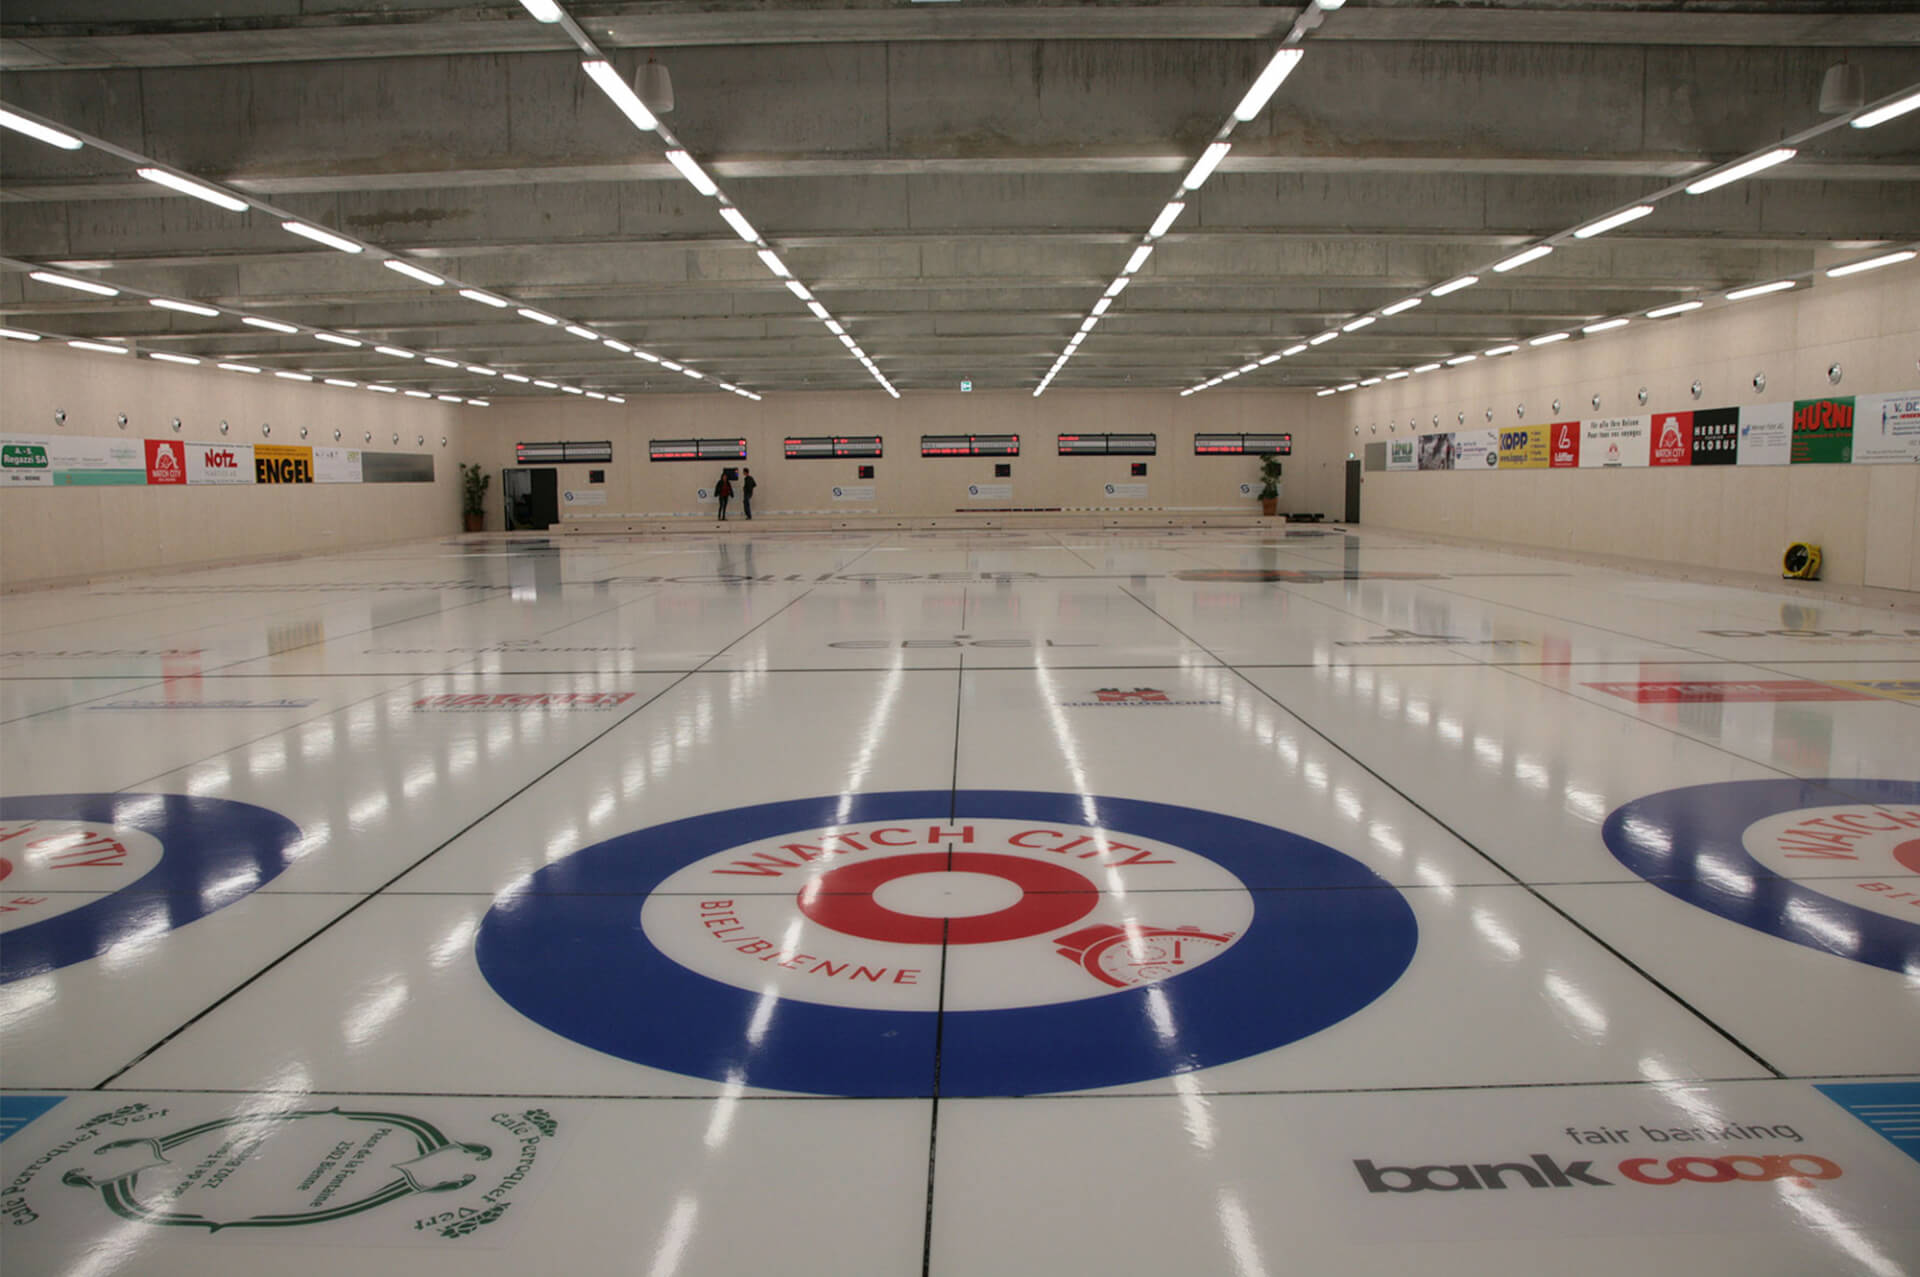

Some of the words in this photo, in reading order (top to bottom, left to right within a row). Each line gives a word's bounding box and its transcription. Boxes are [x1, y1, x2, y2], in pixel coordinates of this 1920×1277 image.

[1793, 400, 1853, 431] HURNI
[1500, 431, 1528, 450] KOPP
[1694, 424, 1736, 436] HERREN
[1693, 439, 1736, 451] GLOBUS
[35, 455, 47, 465] SA
[255, 458, 313, 484] ENGEL
[711, 825, 975, 878] WATCH
[1007, 829, 1178, 871] CITY
[700, 898, 922, 987] BIEL/BIENNE
[109, 1108, 170, 1127] Vert
[1565, 1126, 1631, 1146] fair
[1646, 1121, 1805, 1146] banking
[325, 1140, 355, 1160] 2502
[481, 1135, 541, 1203] Perroquet
[1353, 1153, 1616, 1193] bank
[1617, 1153, 1844, 1189] coop
[414, 1206, 481, 1231] Vert
